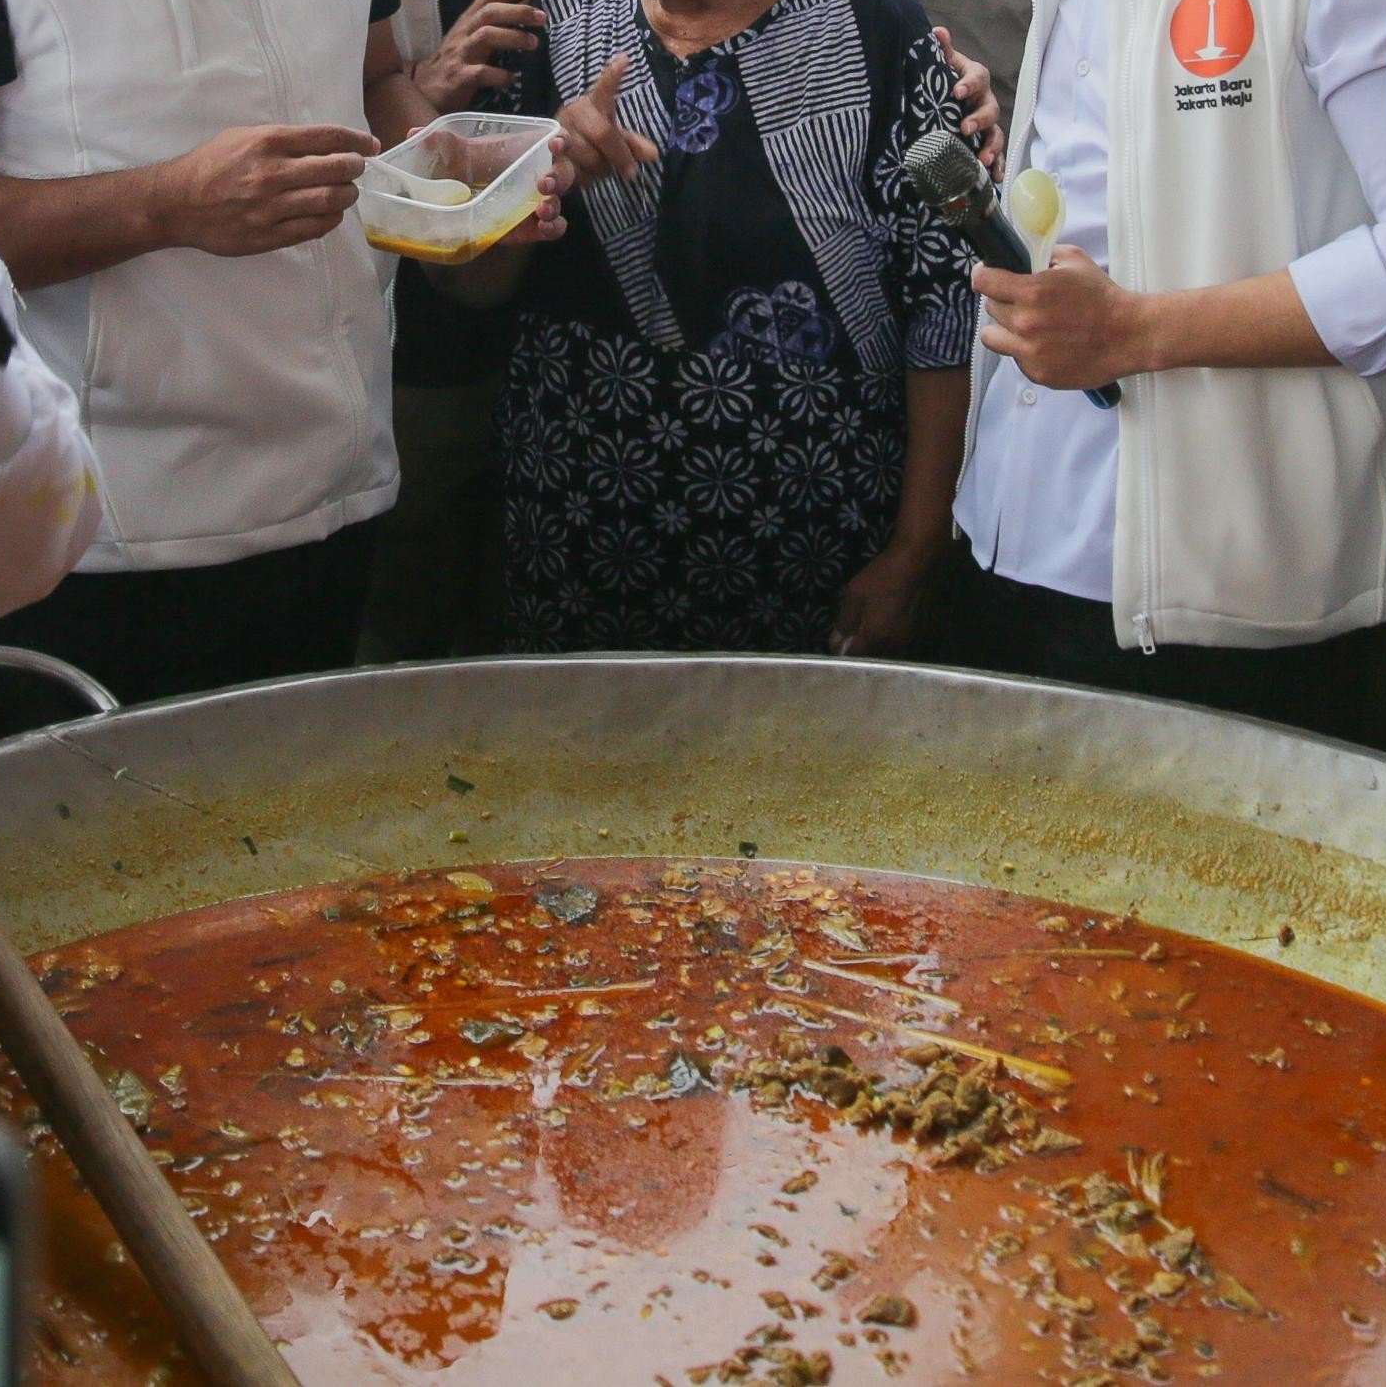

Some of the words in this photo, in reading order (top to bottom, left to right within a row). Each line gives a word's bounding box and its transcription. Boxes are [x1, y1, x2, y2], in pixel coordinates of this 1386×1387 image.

[1174, 83, 1216, 97] Jakarta
[1219, 78, 1253, 92] Baru
[1176, 97, 1217, 111] Jakarta
[1221, 92, 1253, 108] Maju
